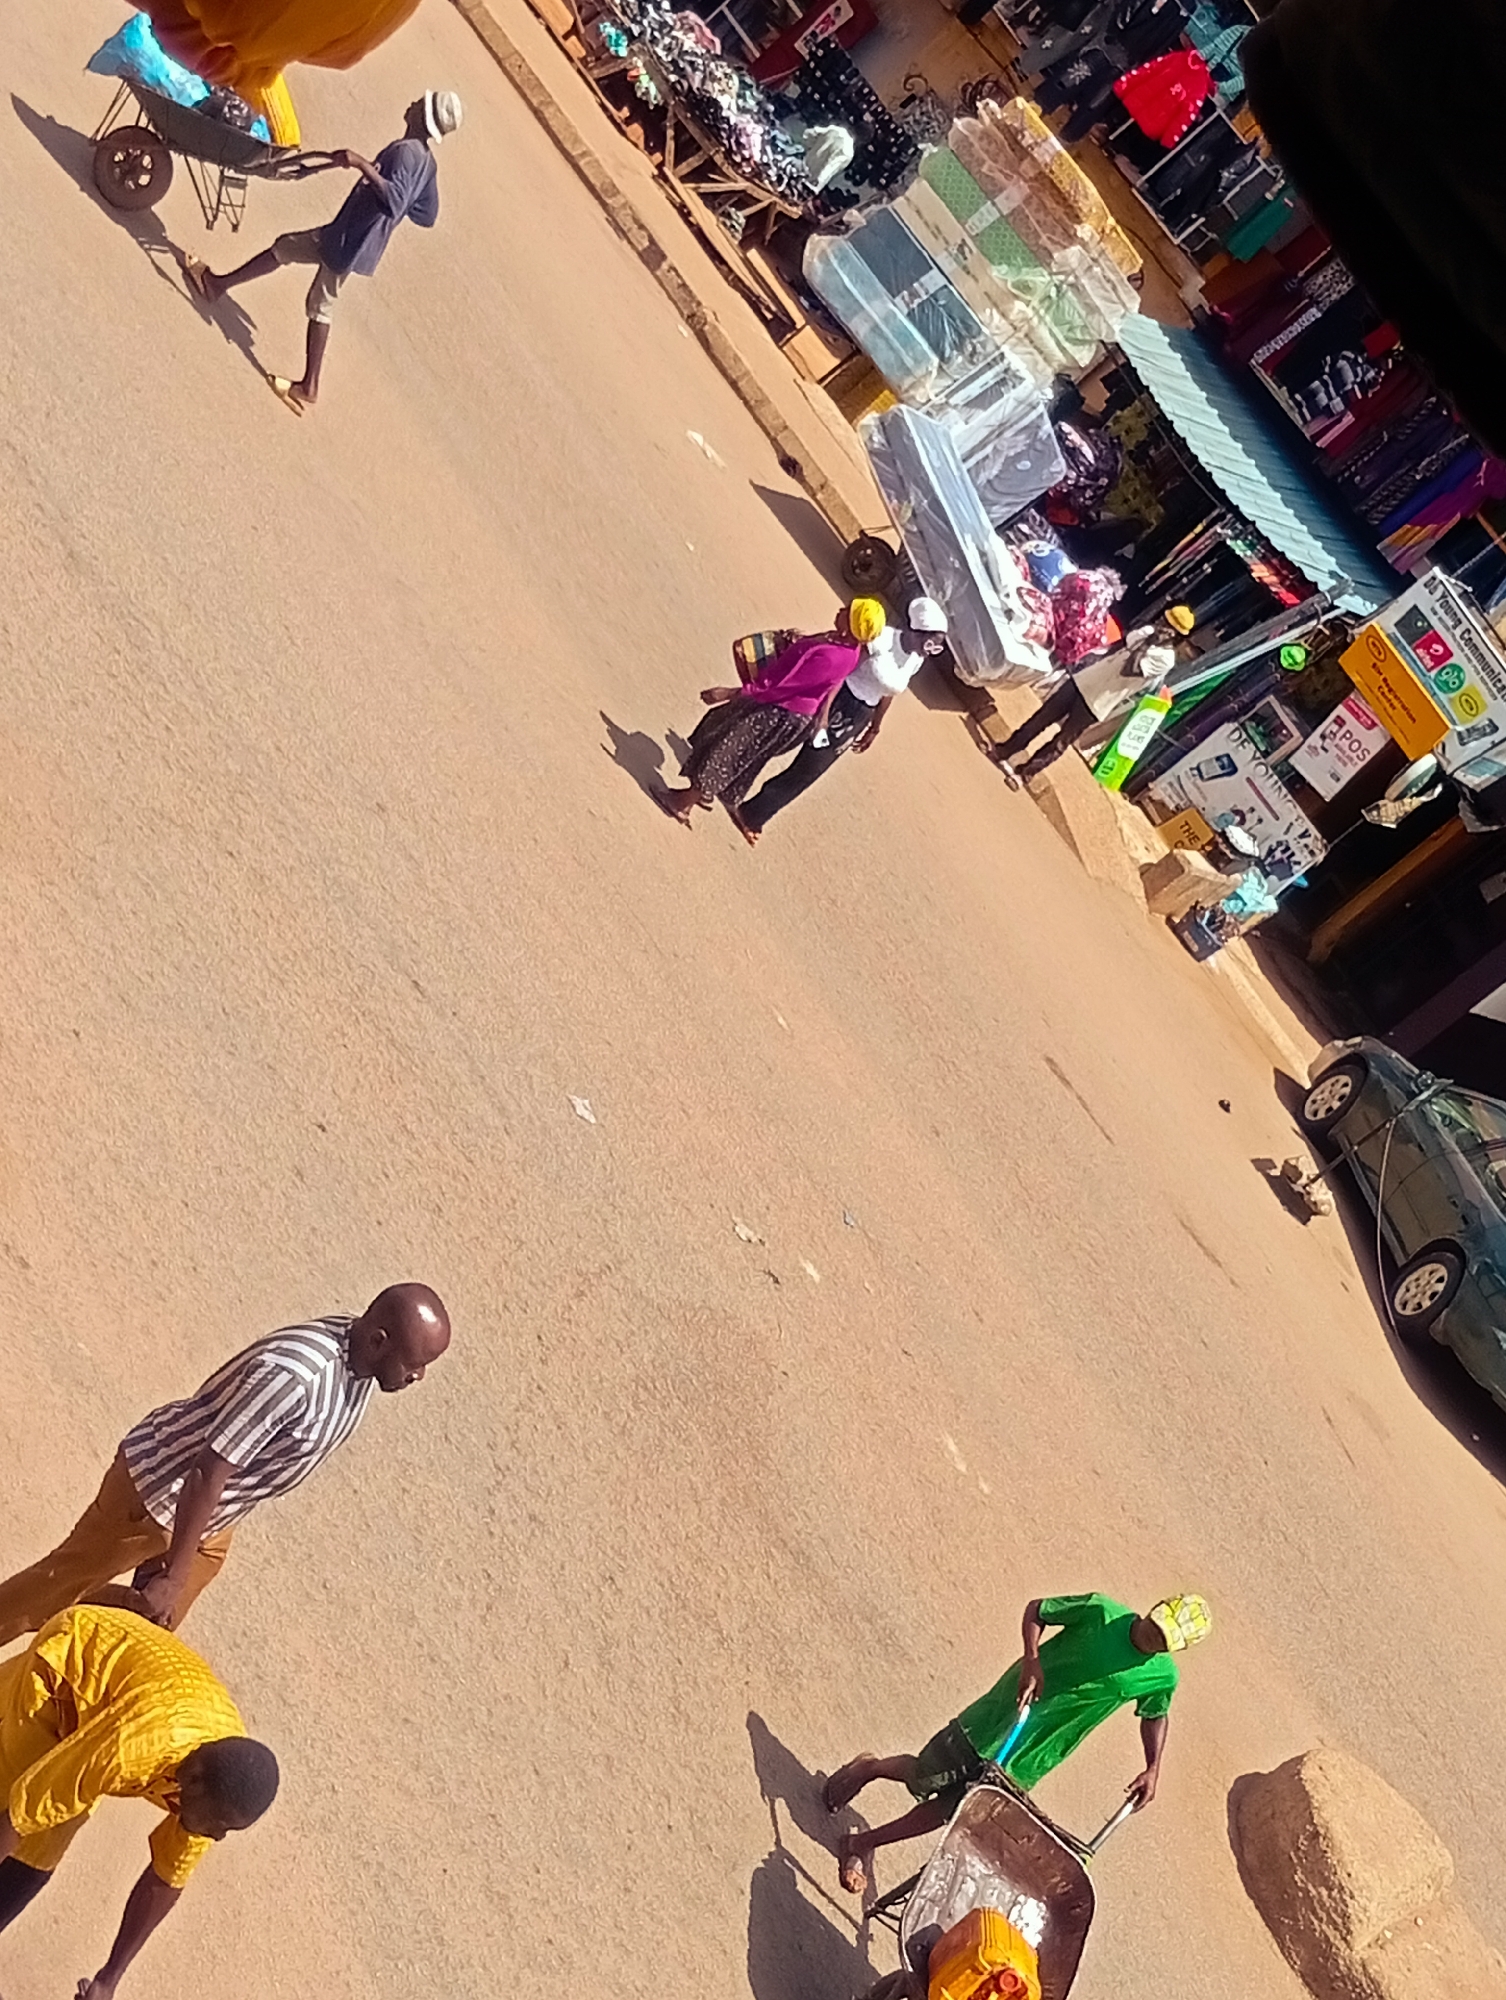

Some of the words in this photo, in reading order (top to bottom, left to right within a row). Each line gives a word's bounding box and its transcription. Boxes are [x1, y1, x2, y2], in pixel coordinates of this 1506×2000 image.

[1435, 590, 1463, 631] Young
[1440, 668, 1460, 689] glo
[1339, 729, 1371, 762] POS
[1179, 820, 1200, 846] THE
